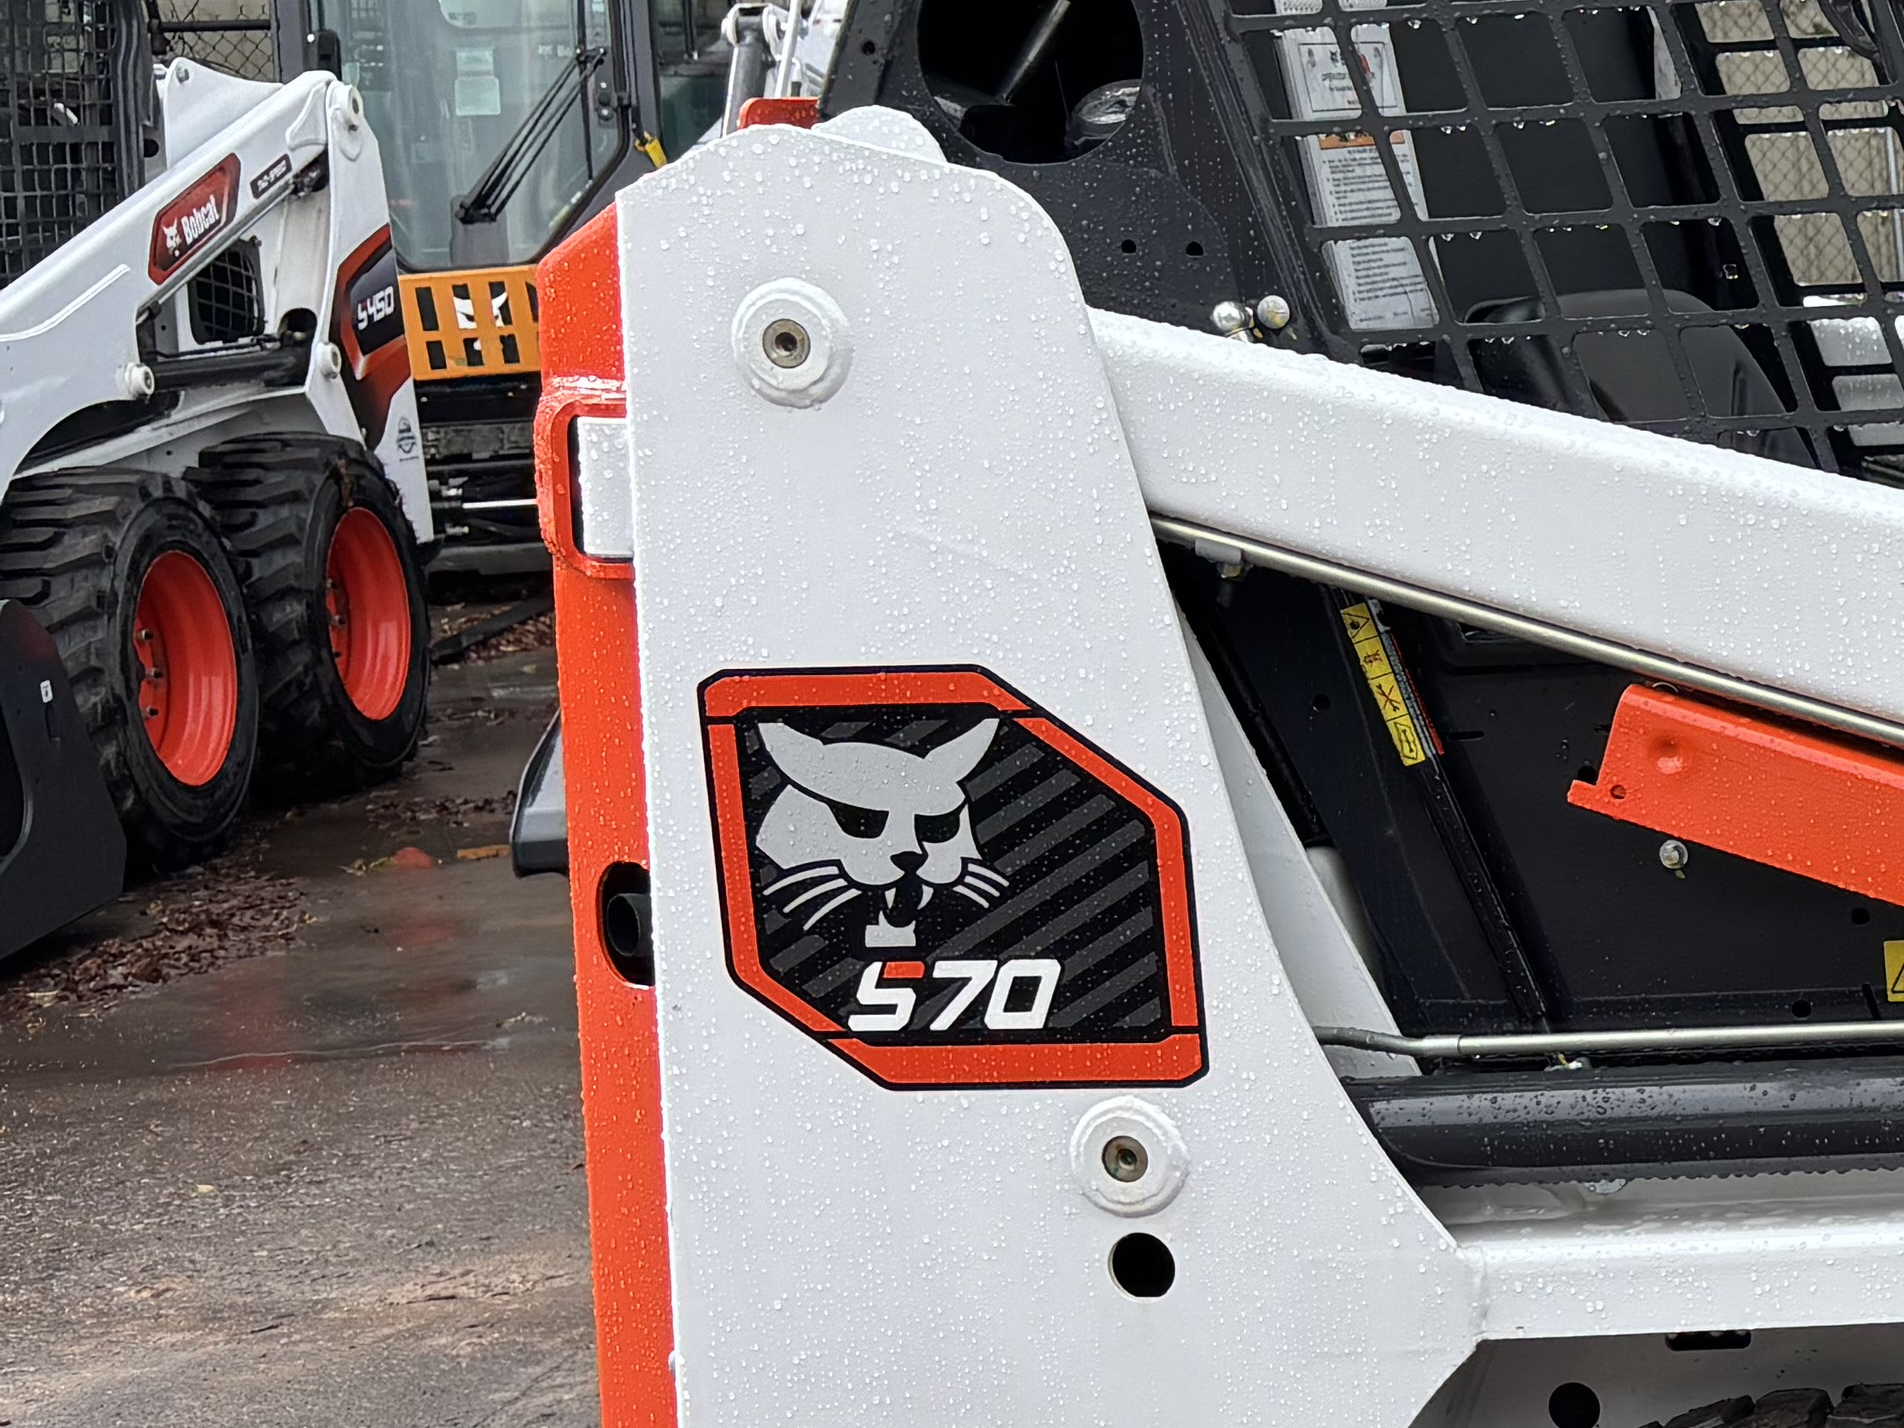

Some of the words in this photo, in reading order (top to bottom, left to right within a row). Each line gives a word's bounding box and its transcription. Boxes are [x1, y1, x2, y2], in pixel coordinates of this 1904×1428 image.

[180, 193, 220, 245] Bobcat
[356, 284, 395, 332] S450
[846, 957, 1061, 1031] S70
